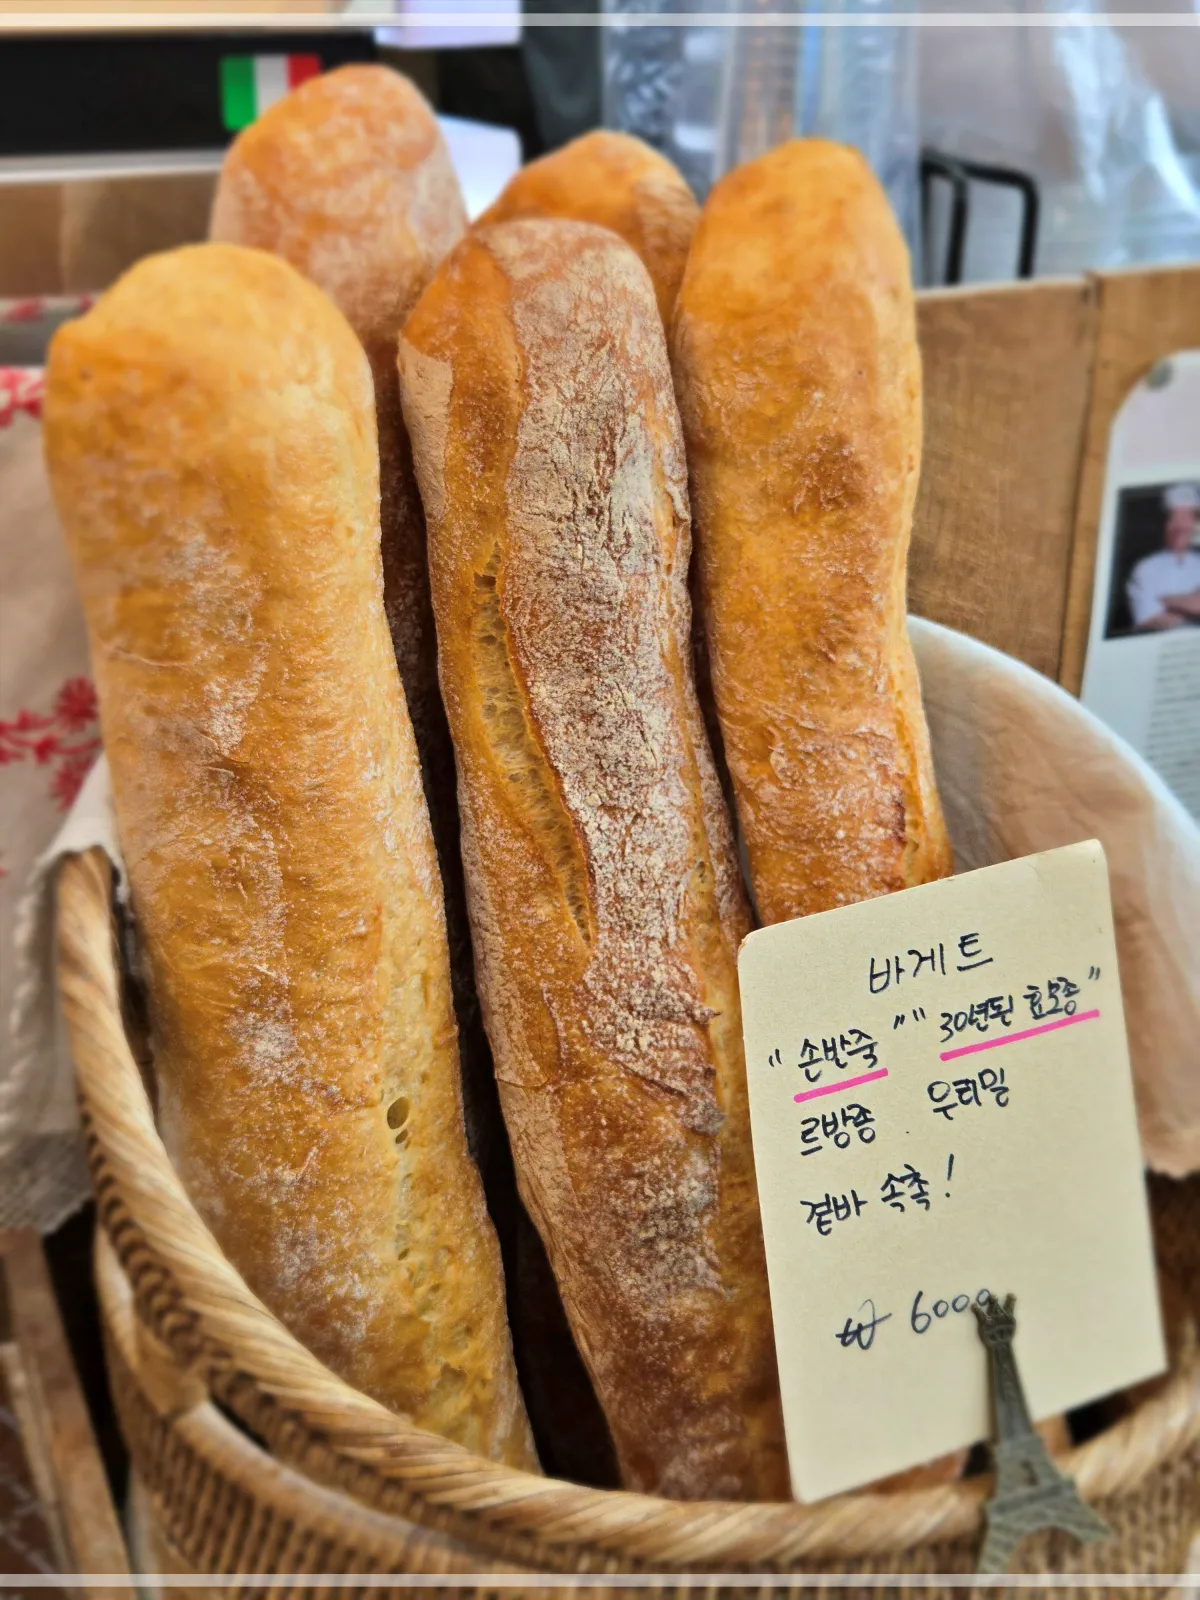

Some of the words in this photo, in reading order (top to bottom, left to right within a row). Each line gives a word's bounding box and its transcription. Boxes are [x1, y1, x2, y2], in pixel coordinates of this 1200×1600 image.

[869, 932, 993, 994] 바게트
[800, 1103, 876, 1156] 르방종
[927, 1067, 1010, 1121] 우리밀
